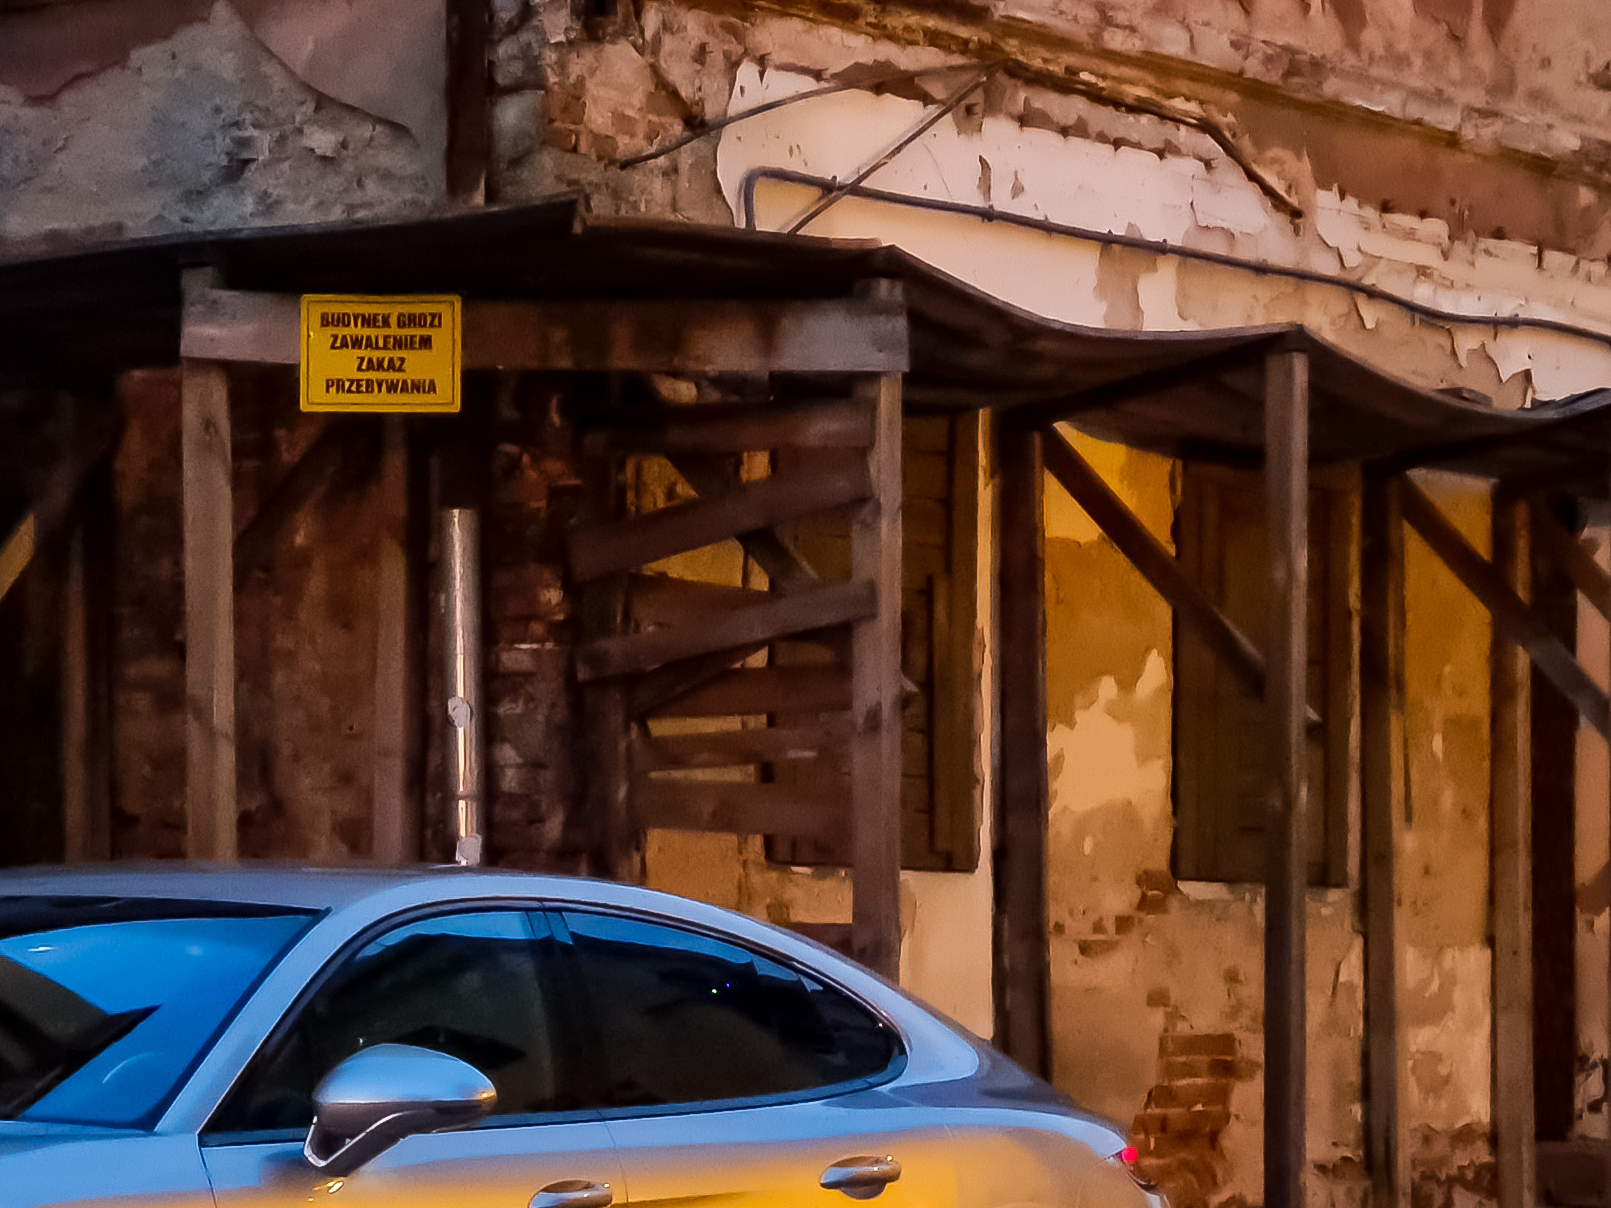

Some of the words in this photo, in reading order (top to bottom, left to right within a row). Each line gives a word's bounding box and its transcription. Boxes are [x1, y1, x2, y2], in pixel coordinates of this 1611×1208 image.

[320, 312, 392, 328] BUDYNEK
[397, 312, 443, 328] GROZI
[330, 333, 433, 350] ZAWALENIEM
[356, 356, 407, 372] ZAKAZ
[325, 378, 437, 395] PRZEBYWANIA
